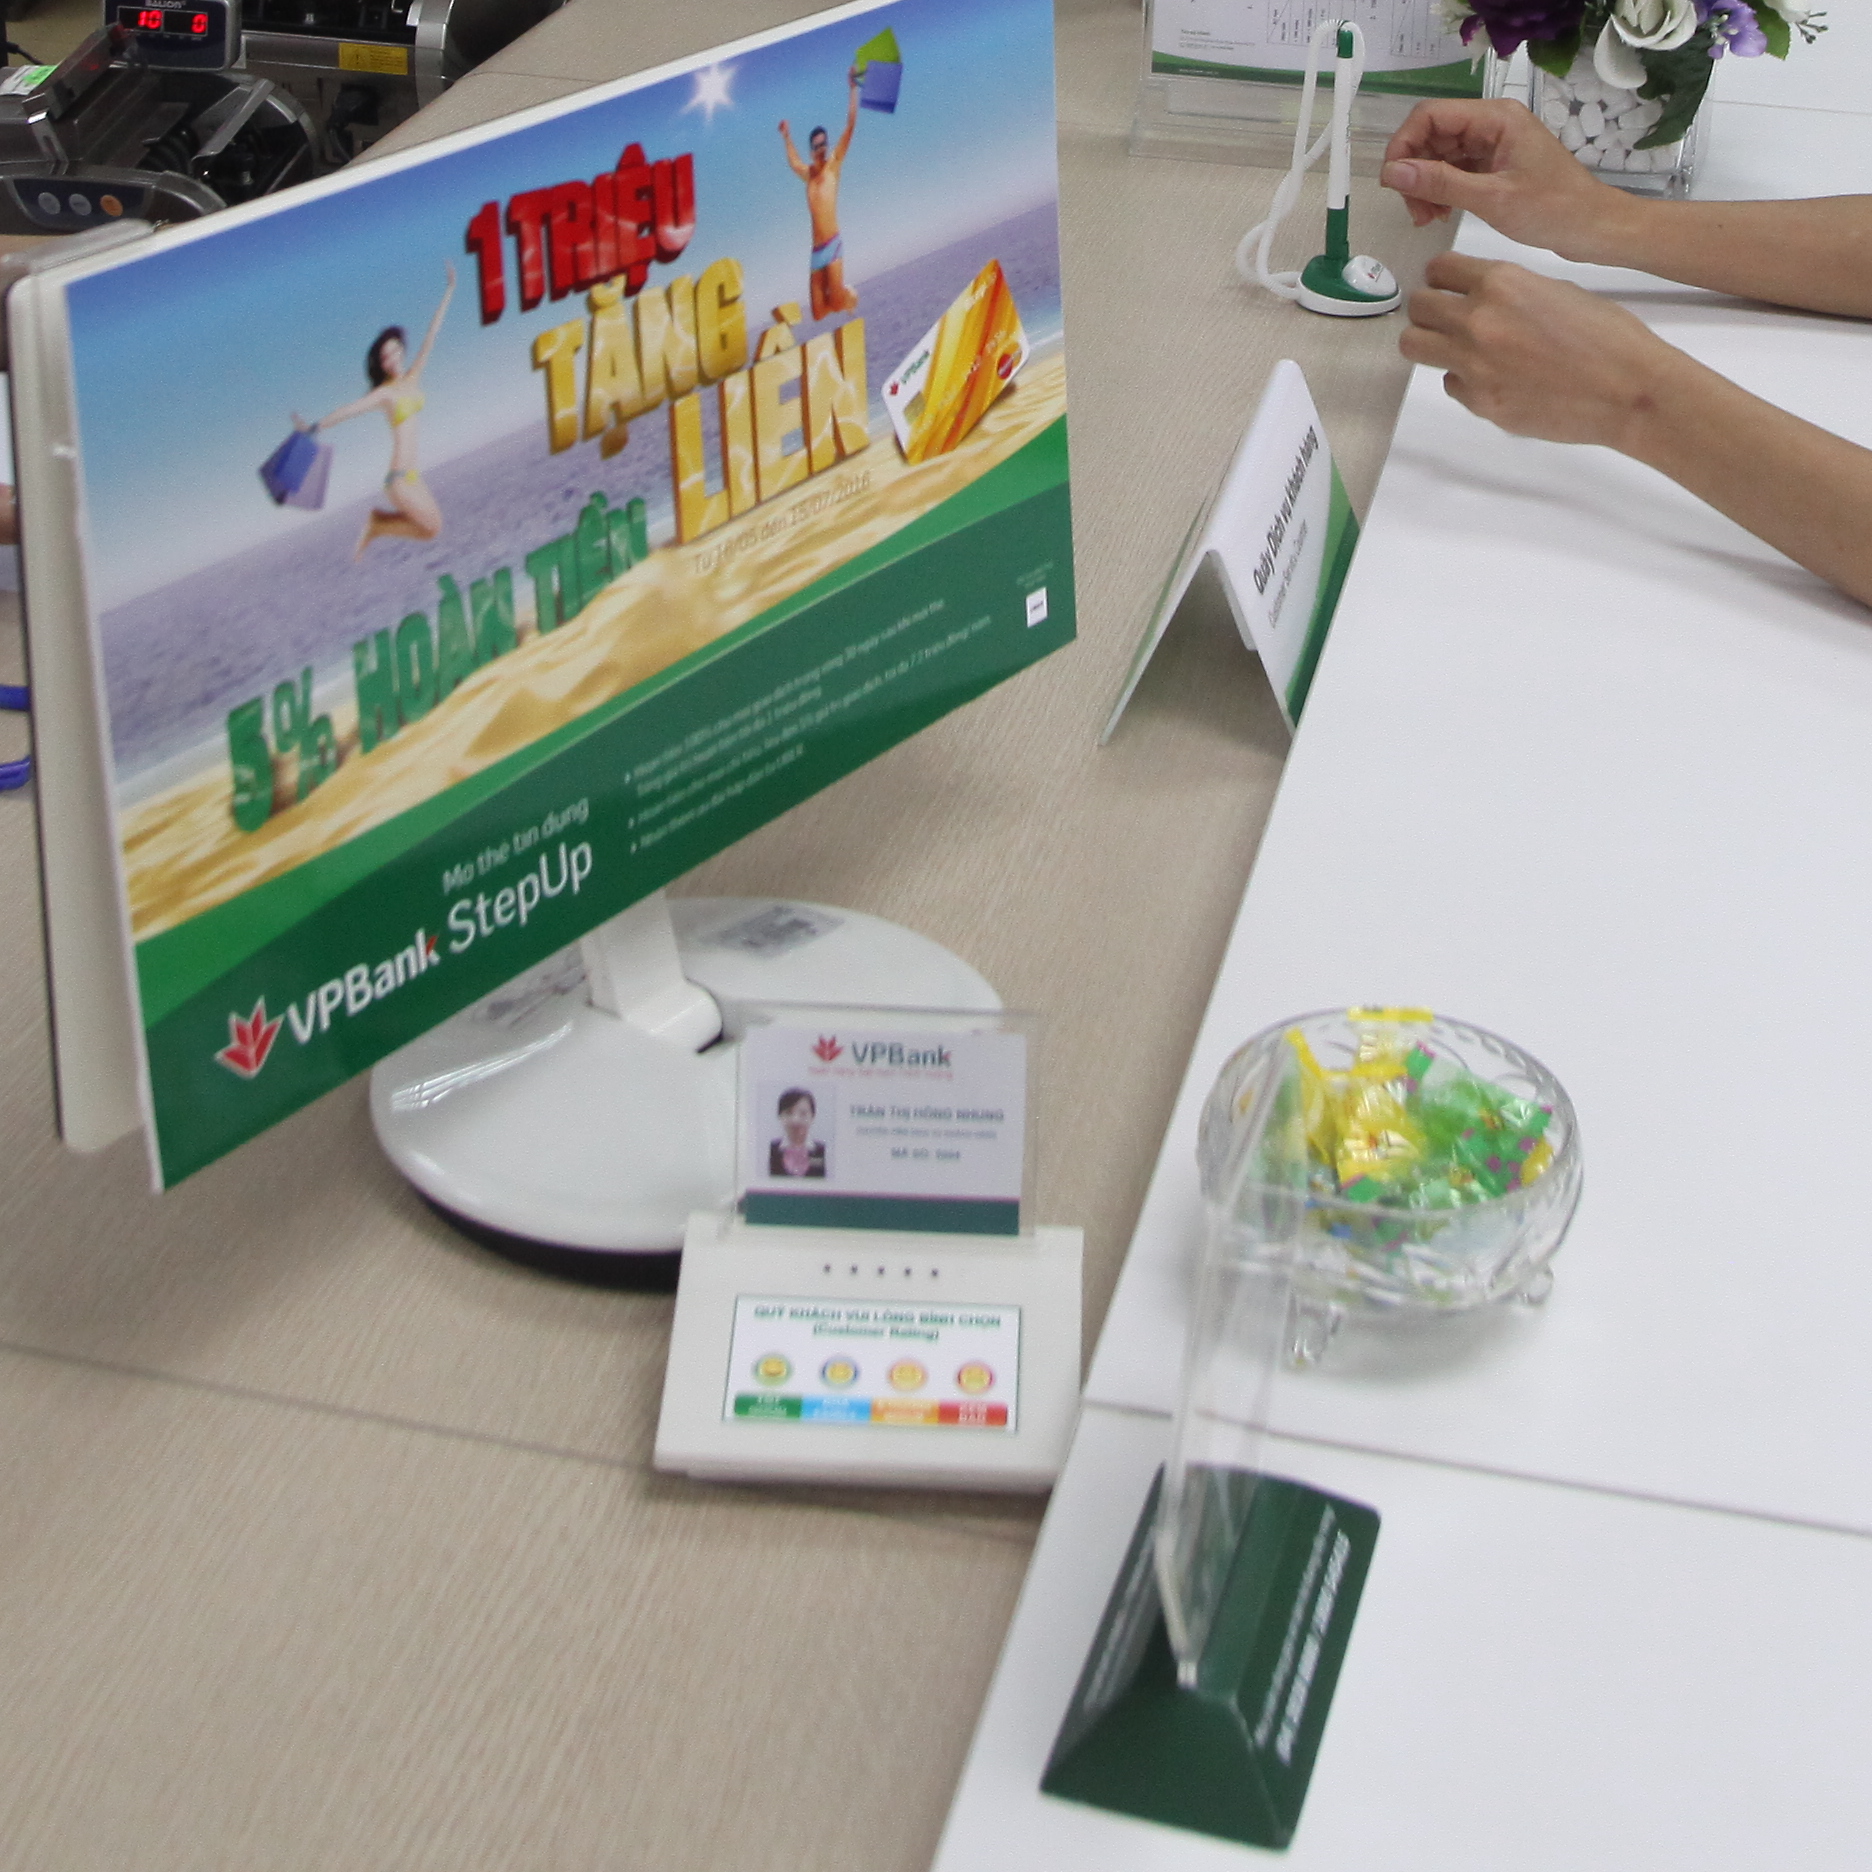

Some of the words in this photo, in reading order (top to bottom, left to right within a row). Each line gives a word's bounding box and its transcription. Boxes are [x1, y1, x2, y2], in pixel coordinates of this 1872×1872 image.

[465, 200, 504, 323] 1
[506, 141, 697, 298] TRIỆU
[533, 256, 746, 457] TẶNG
[668, 303, 870, 544] LIỀN
[227, 666, 338, 833] 5%
[353, 574, 519, 756] HOÀN
[525, 491, 649, 635] TIỀN
[286, 927, 441, 1045] VPBank
[447, 840, 592, 954] StepUp
[851, 1040, 953, 1068] VPBank
